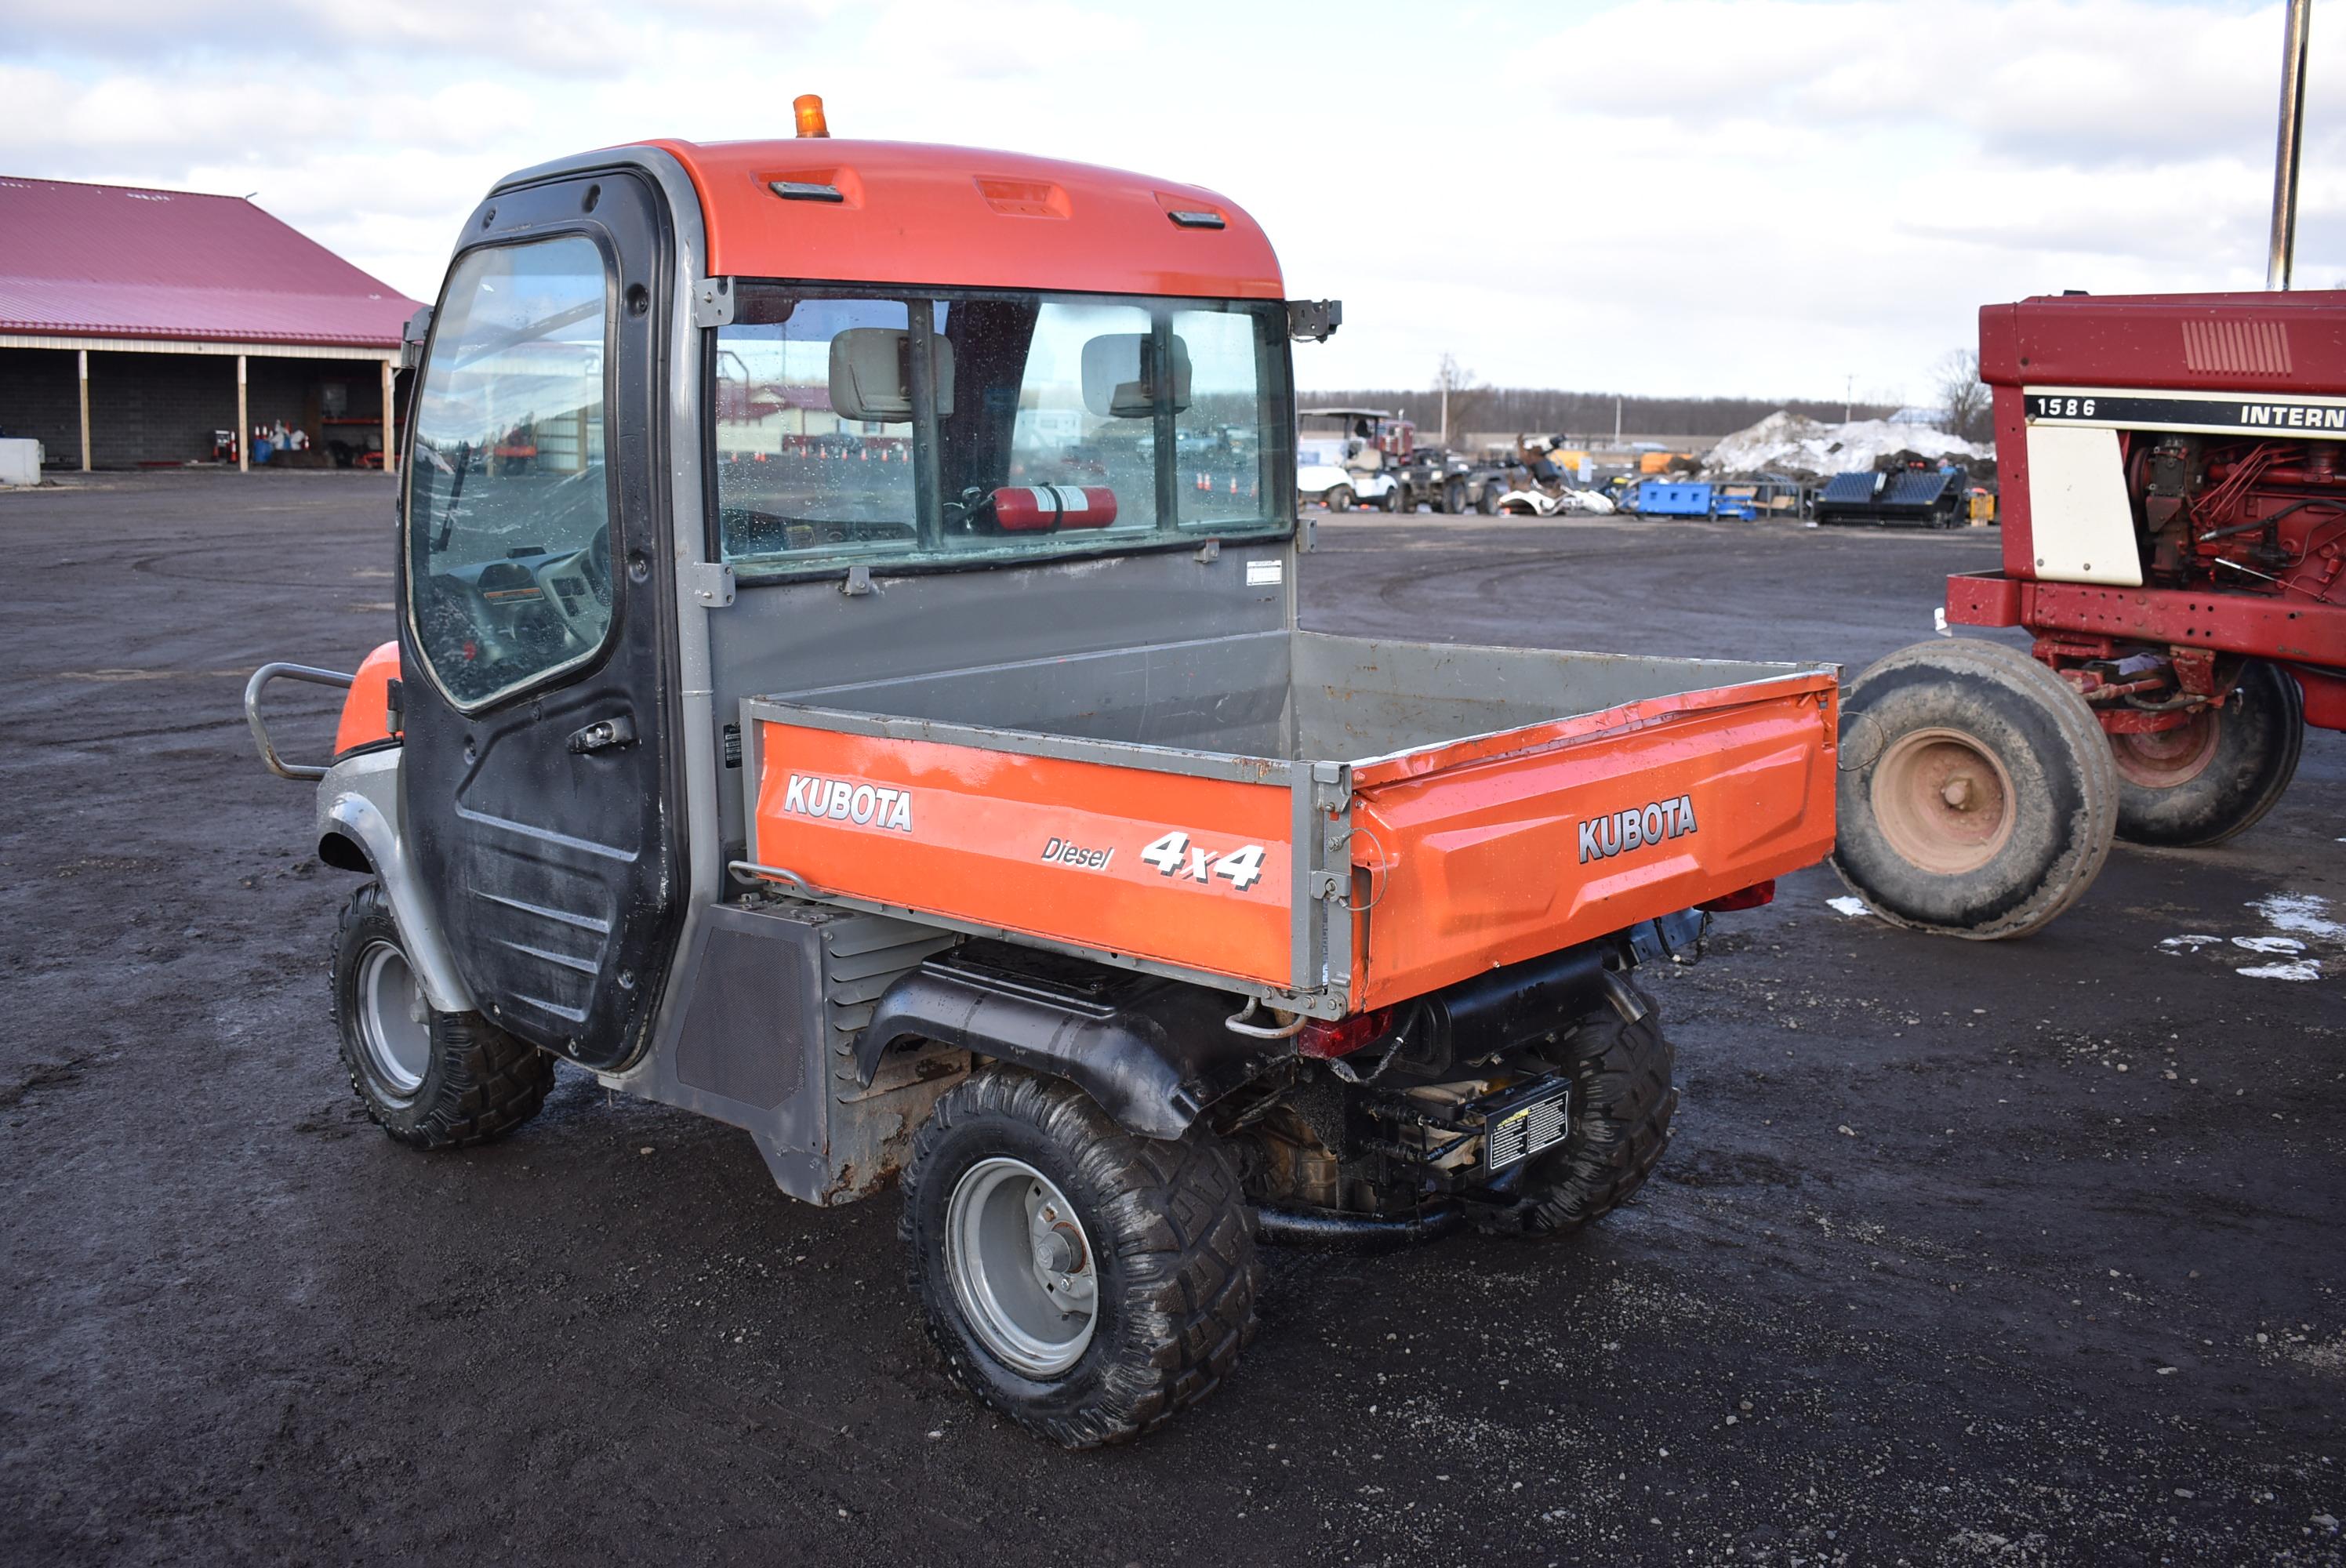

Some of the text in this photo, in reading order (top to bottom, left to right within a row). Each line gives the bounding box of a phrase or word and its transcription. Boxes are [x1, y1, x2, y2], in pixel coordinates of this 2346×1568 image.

[2037, 398, 2096, 417] 1586
[2241, 405, 2346, 428] INTERN
[783, 774, 913, 832] KUBOTA
[1578, 793, 1698, 864] KUBOTA
[1040, 831, 1266, 891] Diesel 4x4
